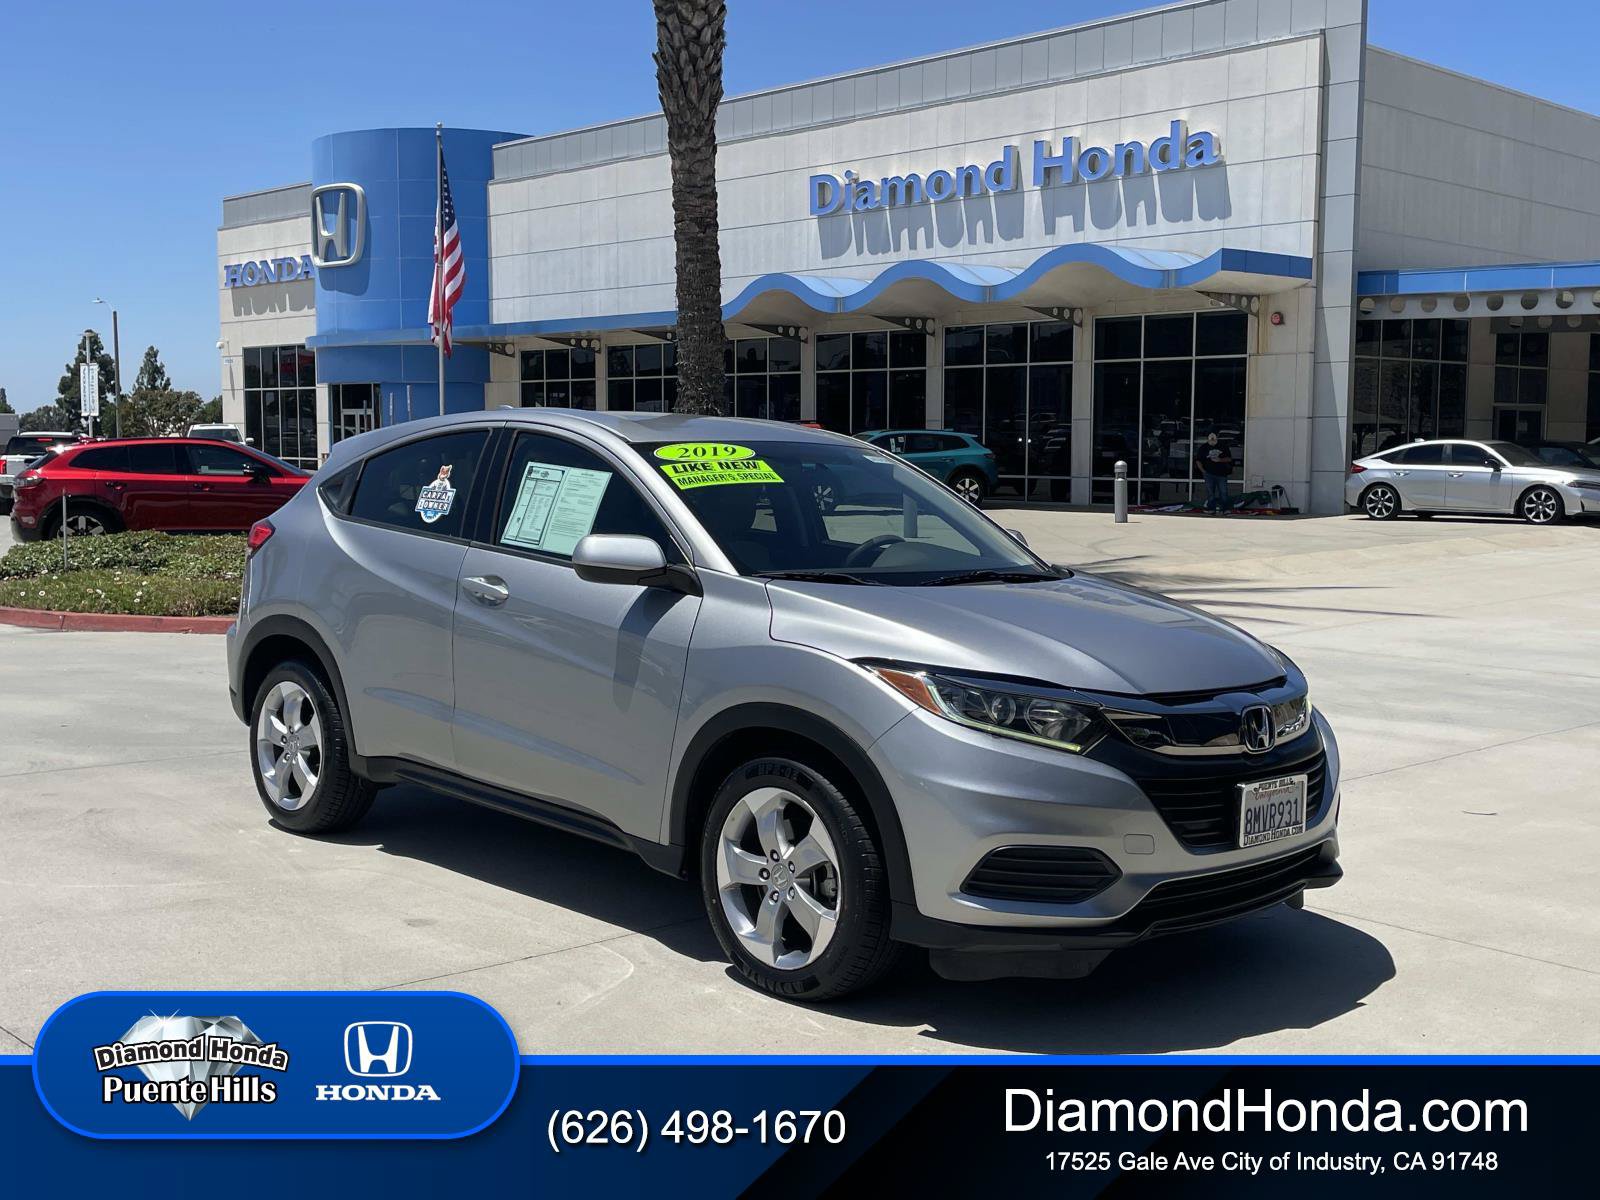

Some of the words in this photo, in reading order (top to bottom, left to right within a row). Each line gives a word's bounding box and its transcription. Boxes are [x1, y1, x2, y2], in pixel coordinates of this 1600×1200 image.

[809, 145, 1019, 217] Diamond
[1032, 119, 1225, 187] Honda
[223, 254, 315, 289] HONDA
[677, 446, 737, 459] 2019
[671, 462, 713, 474] LIKE
[719, 461, 759, 471] NEW
[678, 474, 736, 486] MANAGER'S
[738, 471, 777, 481] SPECIAL
[422, 491, 452, 502] CARFA
[1245, 798, 1300, 836] 8MVR931
